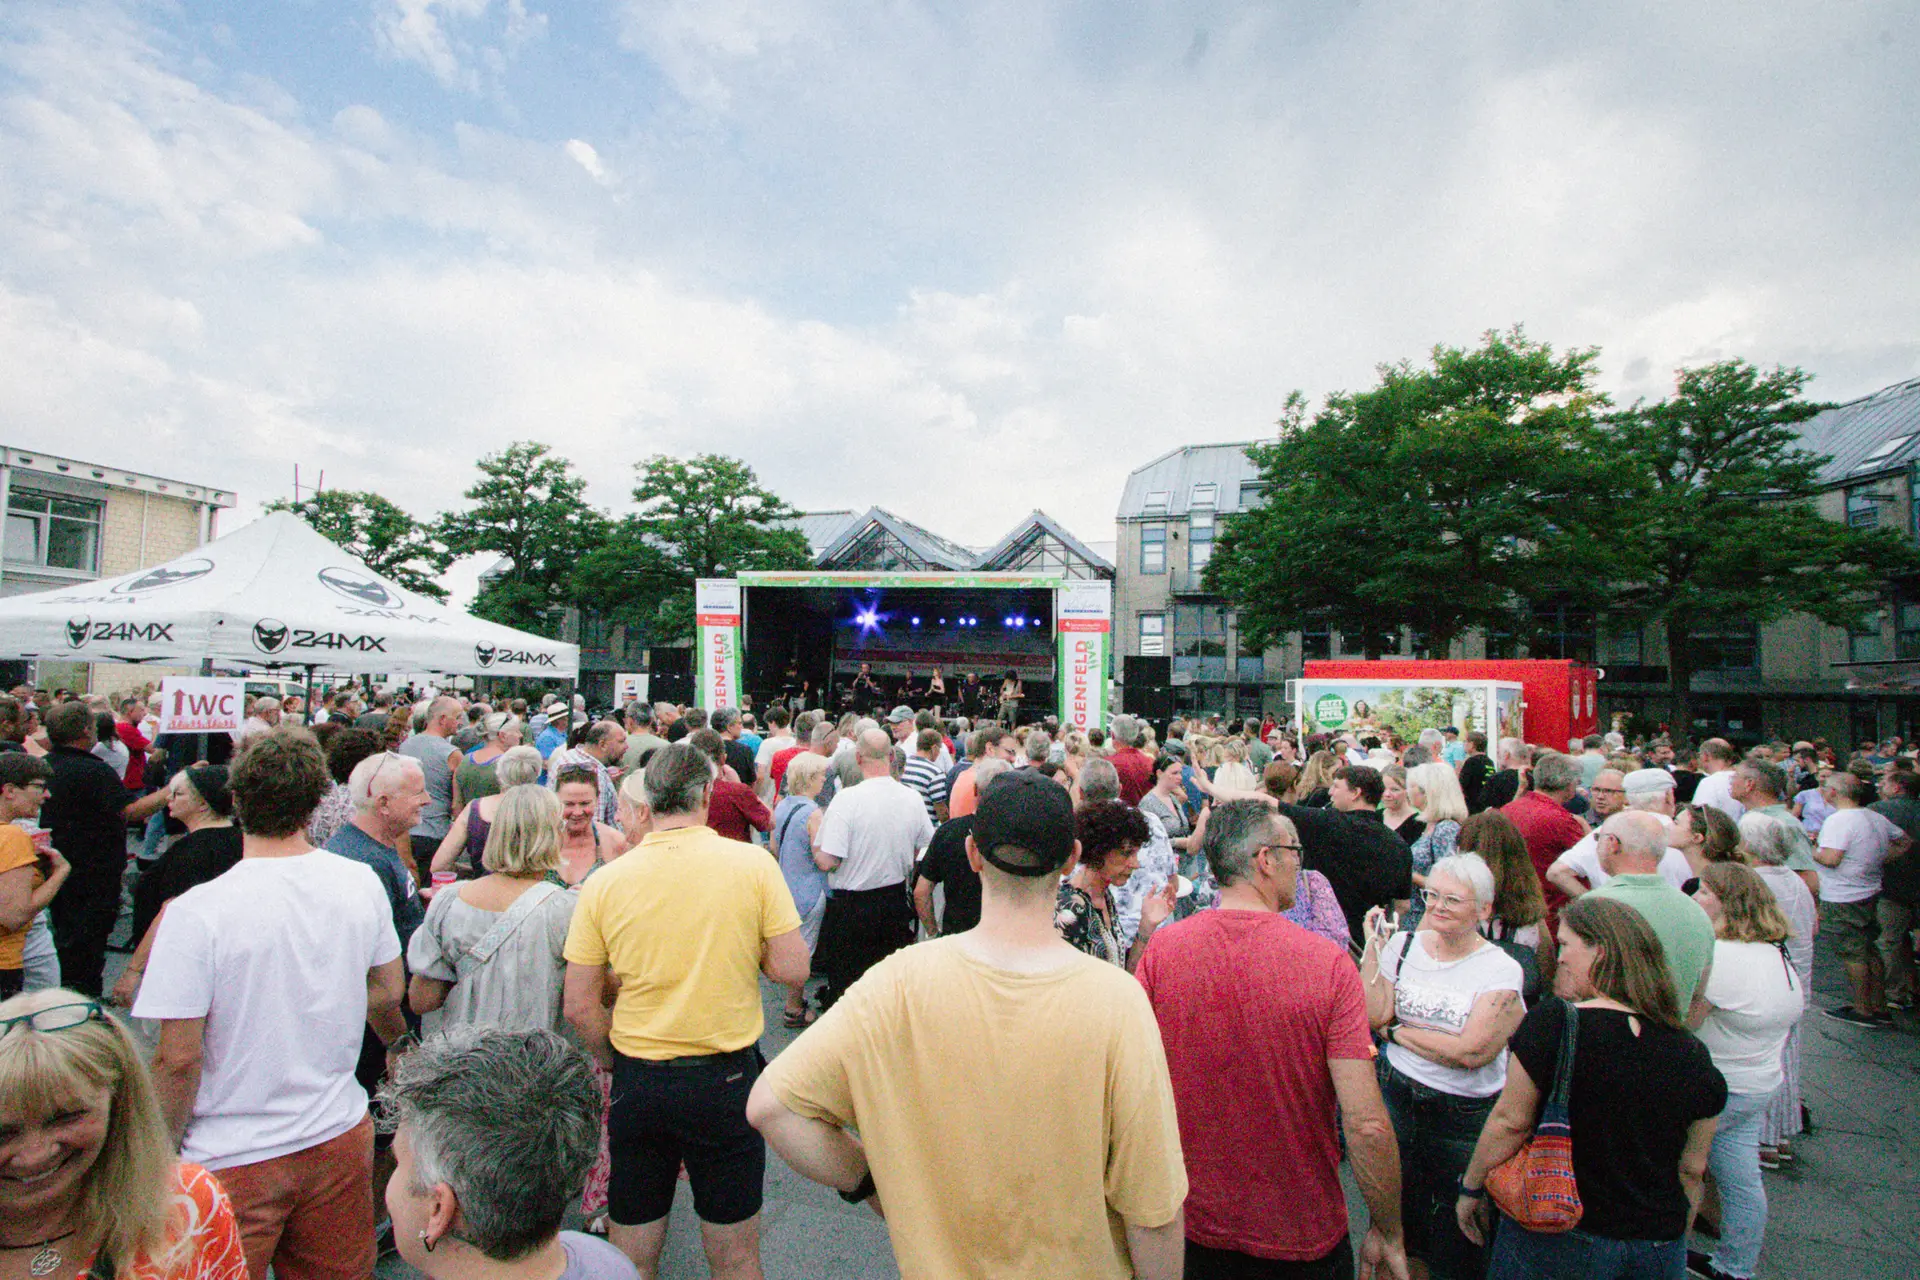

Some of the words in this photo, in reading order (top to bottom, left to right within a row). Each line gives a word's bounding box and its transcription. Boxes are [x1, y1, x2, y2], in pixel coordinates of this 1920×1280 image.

[92, 622, 174, 642] 24MX
[291, 629, 388, 653] 24MX
[497, 649, 557, 668] 24MX
[188, 694, 235, 716] WC
